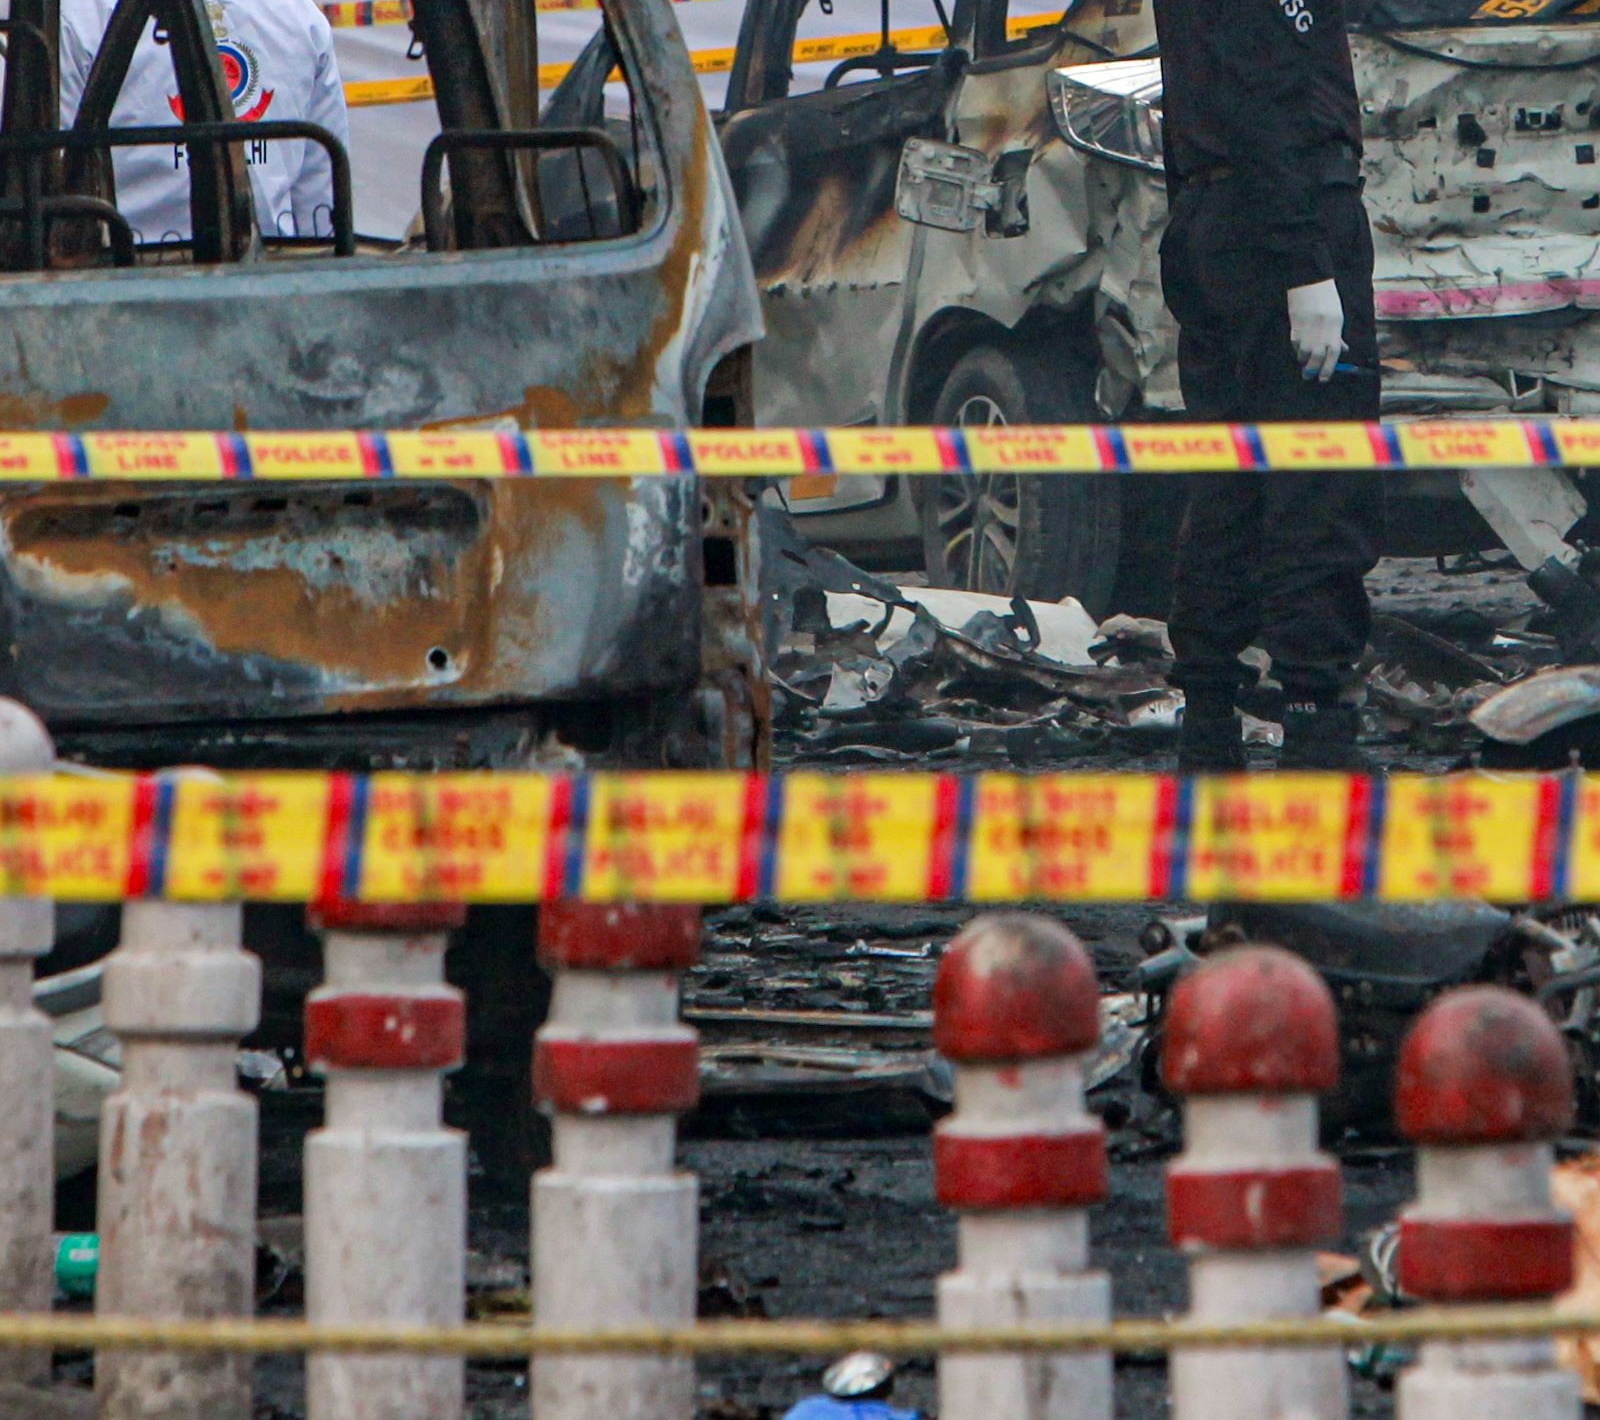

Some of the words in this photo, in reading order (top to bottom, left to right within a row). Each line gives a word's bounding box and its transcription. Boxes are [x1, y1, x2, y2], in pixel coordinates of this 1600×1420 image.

[255, 448, 353, 464] POLICE
[698, 444, 791, 460] POLICE
[1000, 448, 1061, 464] LINE
[1133, 440, 1225, 457] POLICE
[1431, 444, 1491, 459] LINE
[118, 454, 179, 470] LINE
[562, 452, 621, 468] LINE
[1195, 850, 1324, 883] POLICE
